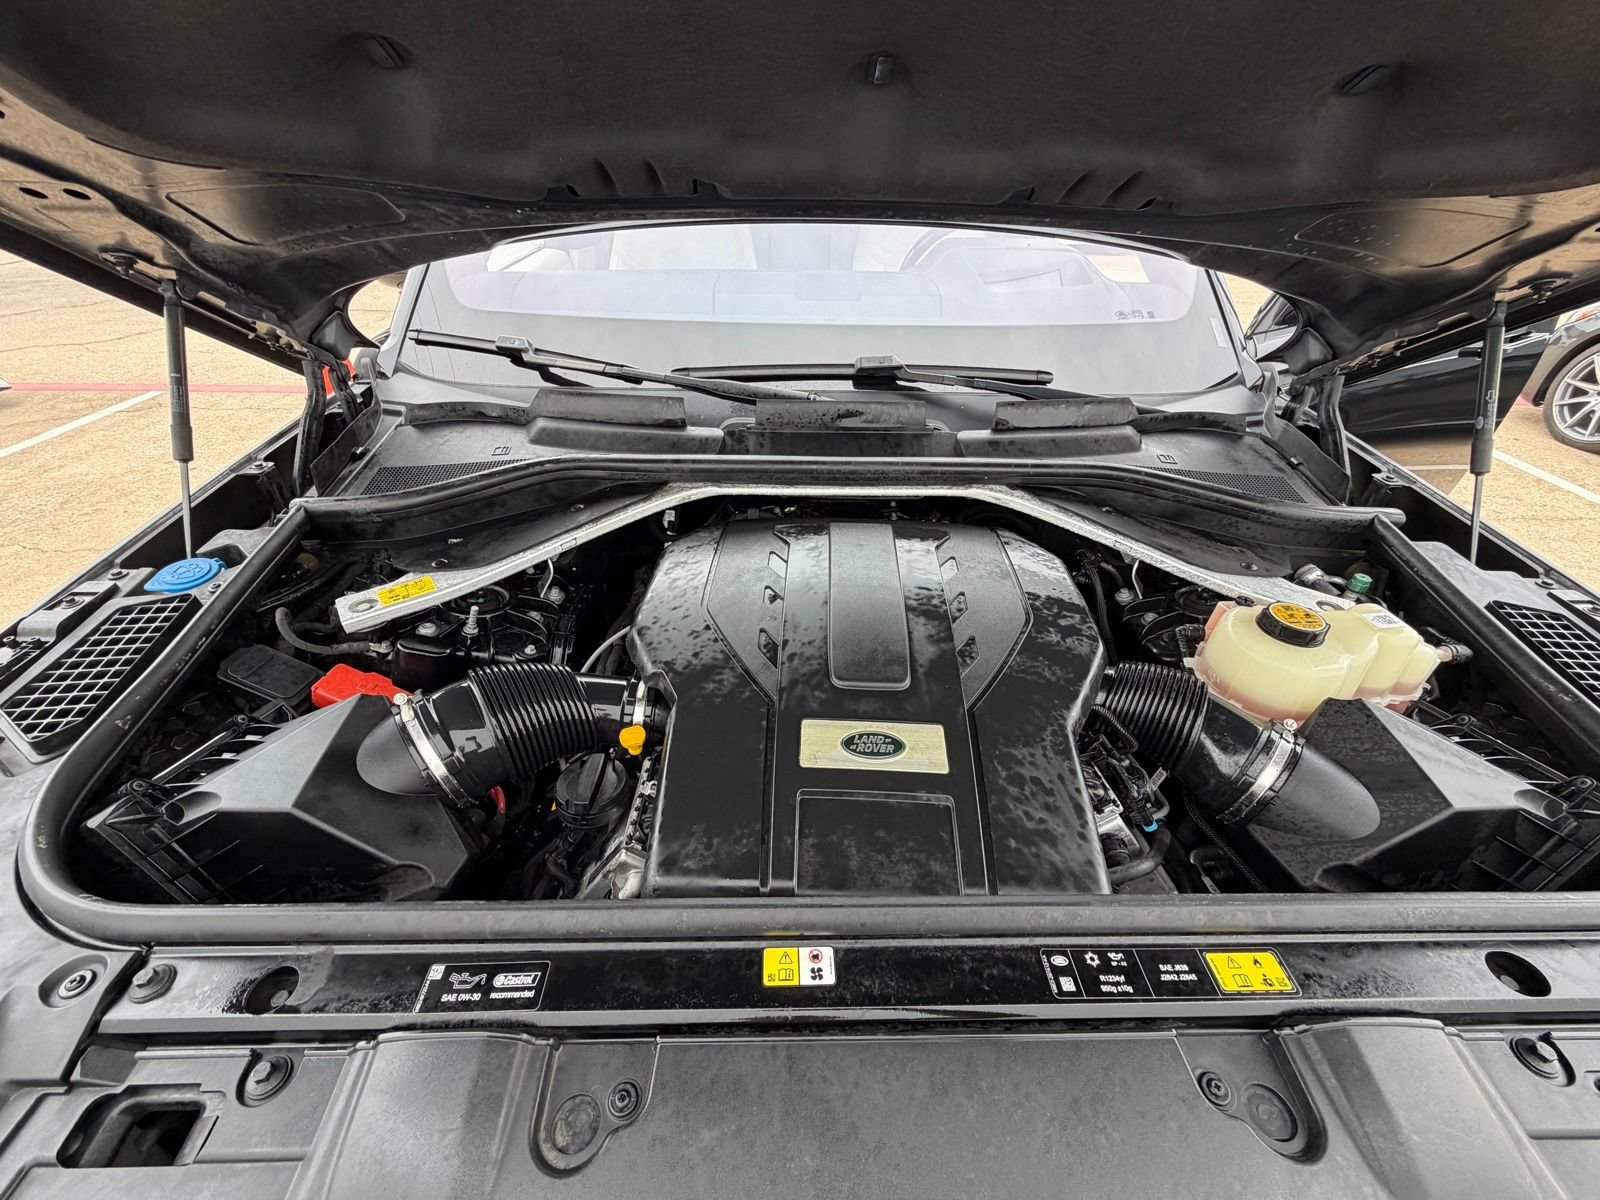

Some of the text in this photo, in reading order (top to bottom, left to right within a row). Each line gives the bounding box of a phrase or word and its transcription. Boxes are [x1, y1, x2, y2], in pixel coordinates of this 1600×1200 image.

[853, 735, 885, 744] LAND
[856, 743, 895, 753] ROVER
[503, 974, 535, 986] Castrol
[441, 992, 482, 1002] SAE 0W-30
[489, 989, 535, 1000] recommended
